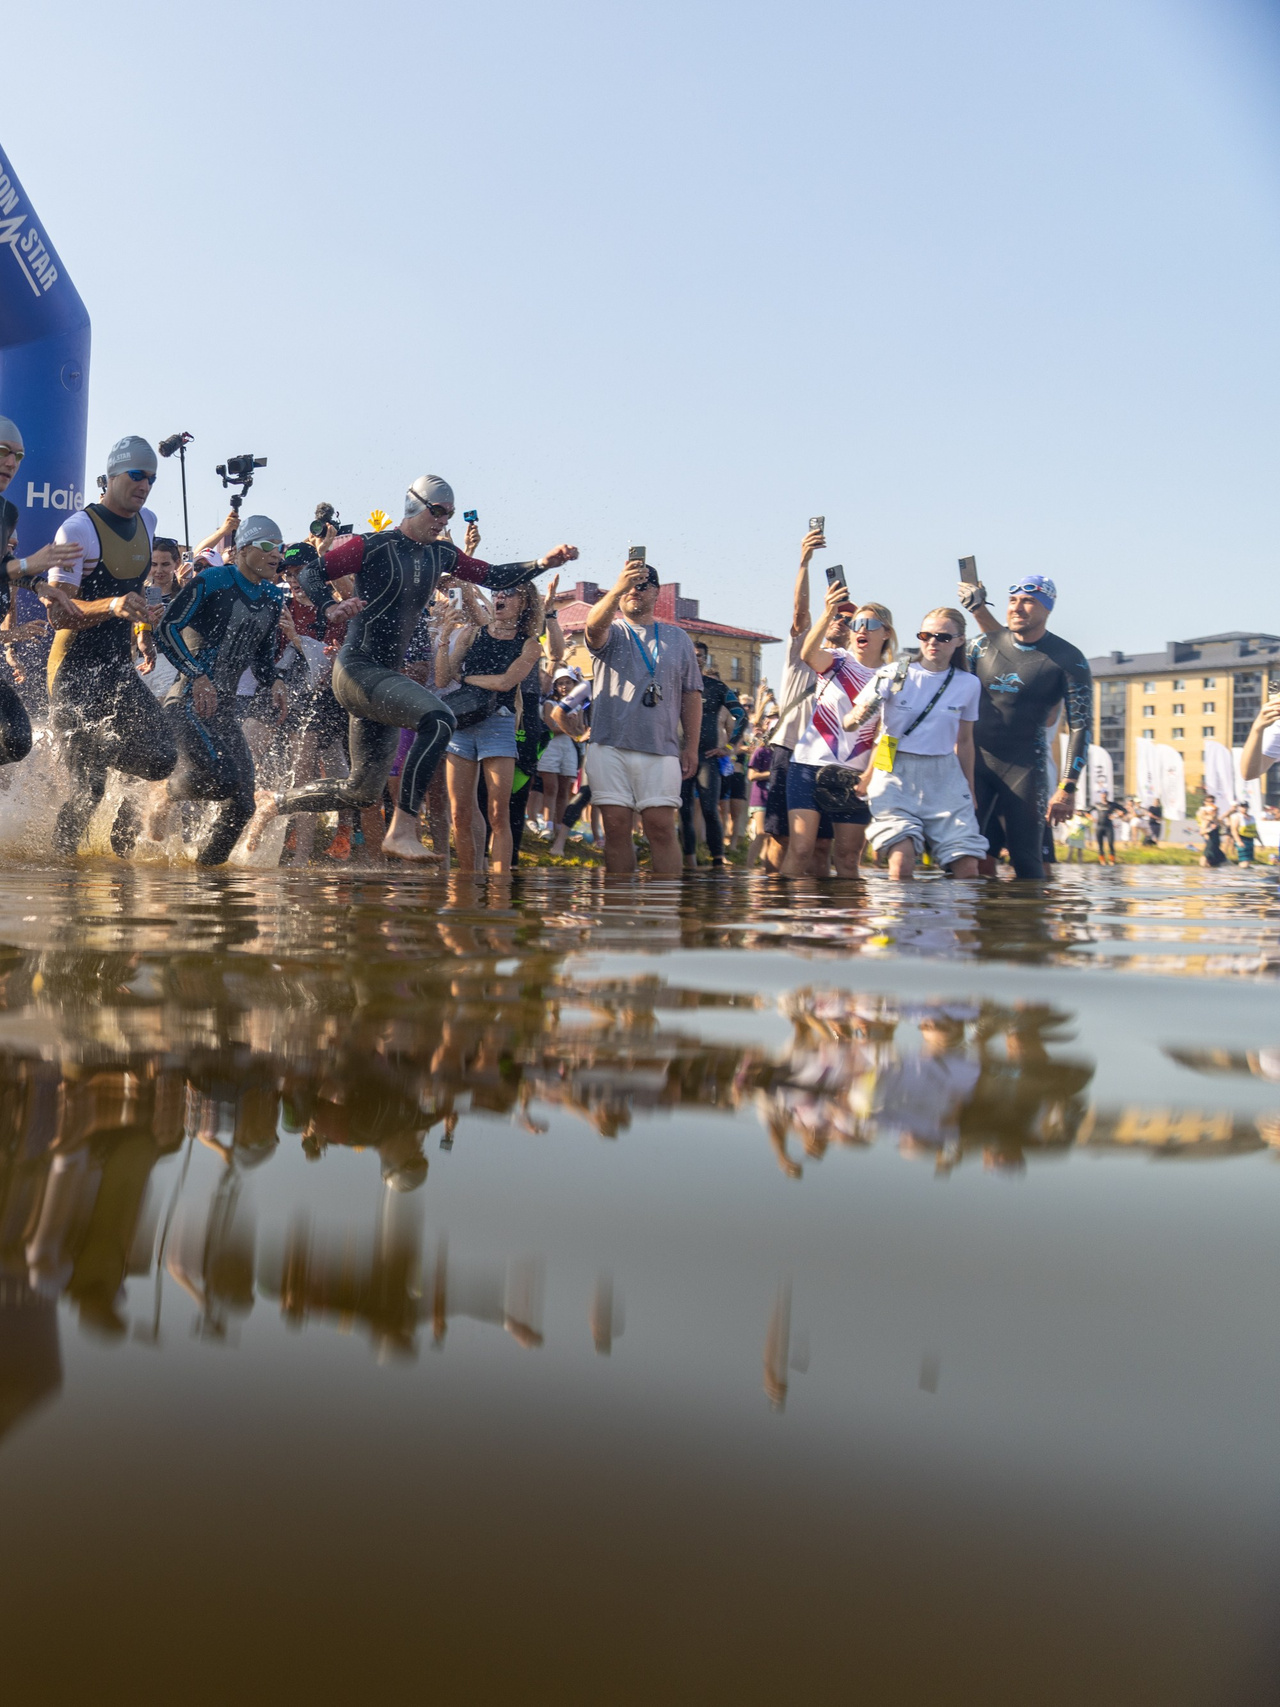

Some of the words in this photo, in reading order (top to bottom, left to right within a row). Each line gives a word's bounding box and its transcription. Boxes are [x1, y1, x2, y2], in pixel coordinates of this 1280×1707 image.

[21, 228, 58, 291] STAR
[117, 452, 131, 460] STAR
[26, 482, 84, 511] Haie
[243, 527, 258, 538] STAR
